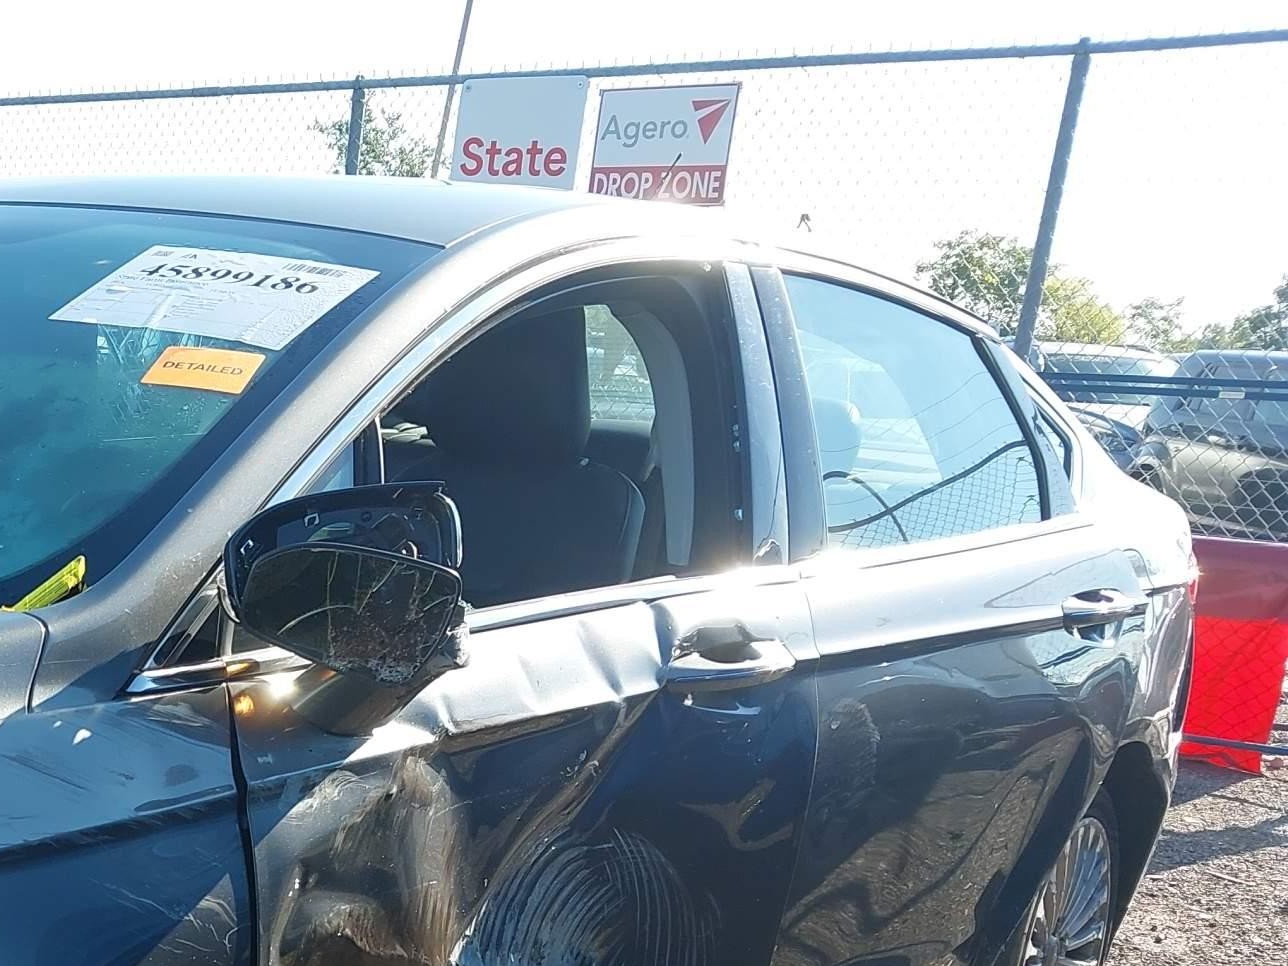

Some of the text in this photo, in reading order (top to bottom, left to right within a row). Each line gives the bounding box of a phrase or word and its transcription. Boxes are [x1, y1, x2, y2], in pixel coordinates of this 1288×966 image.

[601, 114, 688, 148] Agero
[459, 136, 567, 177] State
[593, 170, 723, 199] DROP ZONE
[139, 261, 320, 295] 45899186
[162, 360, 244, 376] DETAILED
